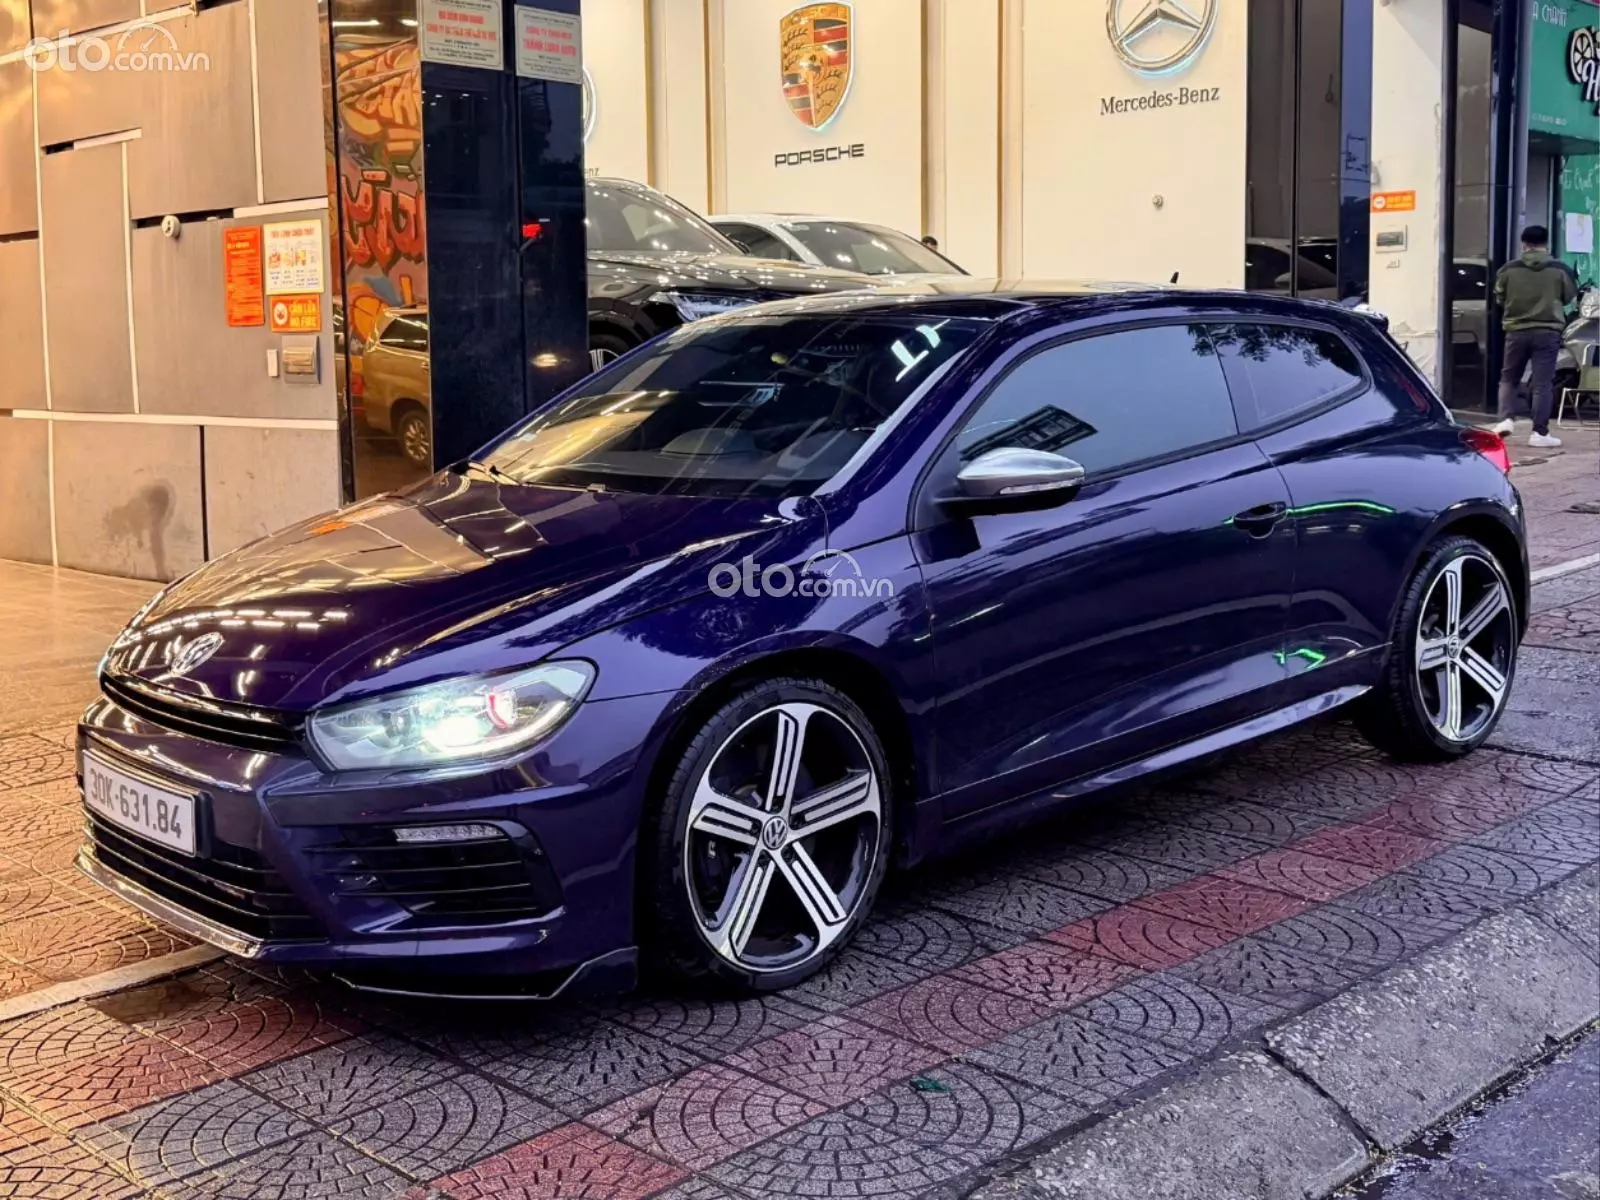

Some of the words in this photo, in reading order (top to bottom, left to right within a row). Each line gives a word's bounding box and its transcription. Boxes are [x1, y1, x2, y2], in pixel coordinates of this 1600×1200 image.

[1100, 87, 1220, 115] Mercedes-Benz
[774, 143, 865, 167] PORSCHE
[90, 767, 182, 840] 30K-631.84
